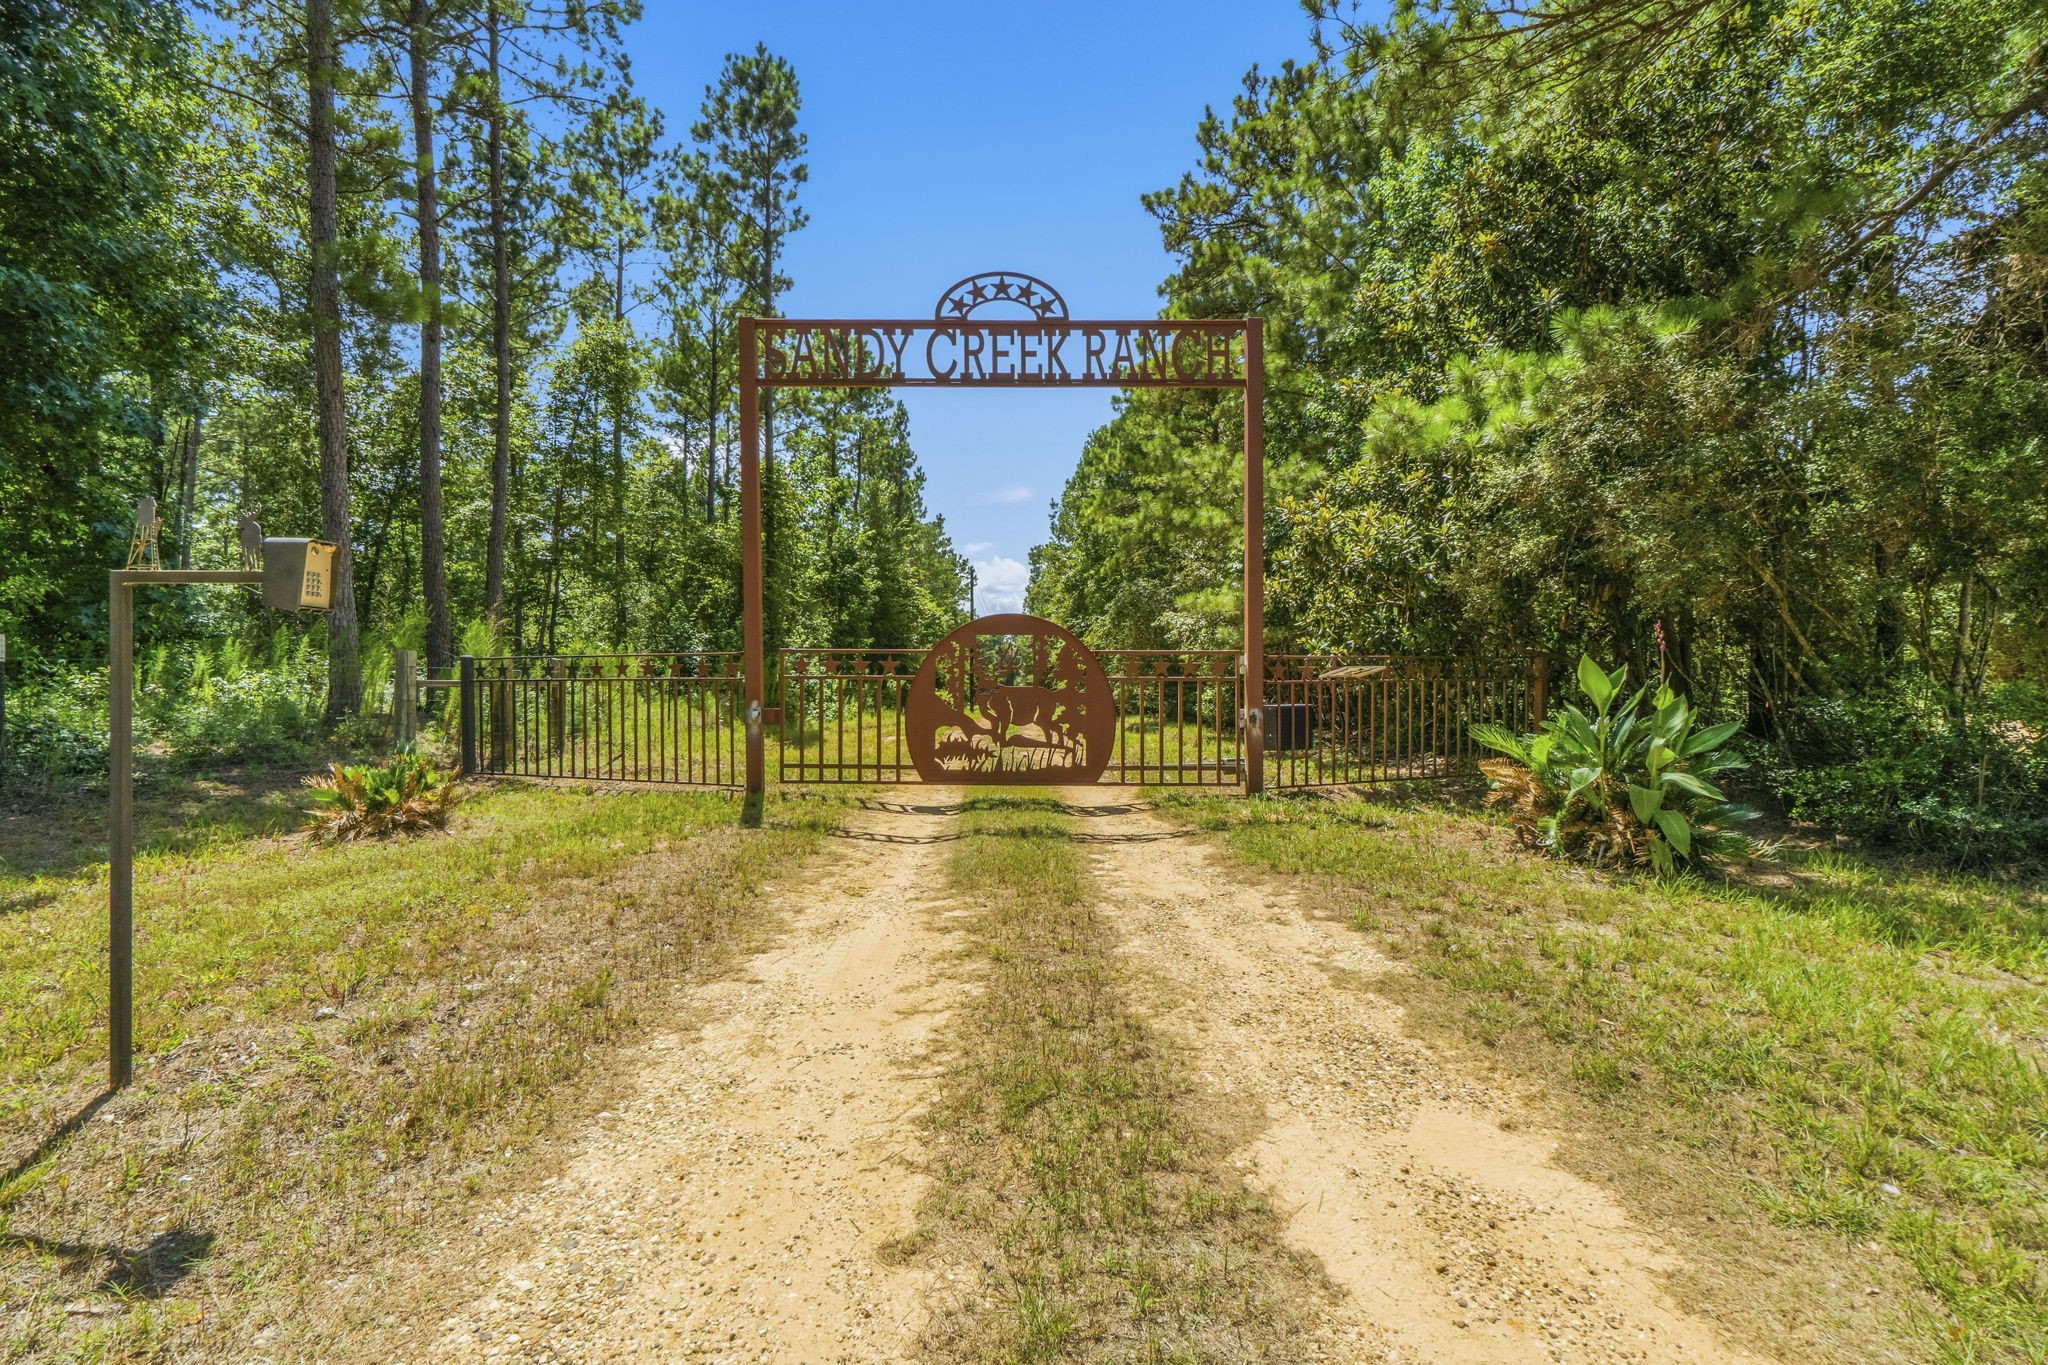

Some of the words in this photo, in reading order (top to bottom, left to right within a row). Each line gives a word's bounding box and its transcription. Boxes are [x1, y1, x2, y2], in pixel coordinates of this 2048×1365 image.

[764, 327, 914, 381] SANDY
[926, 327, 1072, 382] CREEK
[1082, 327, 1234, 381] RANCH
